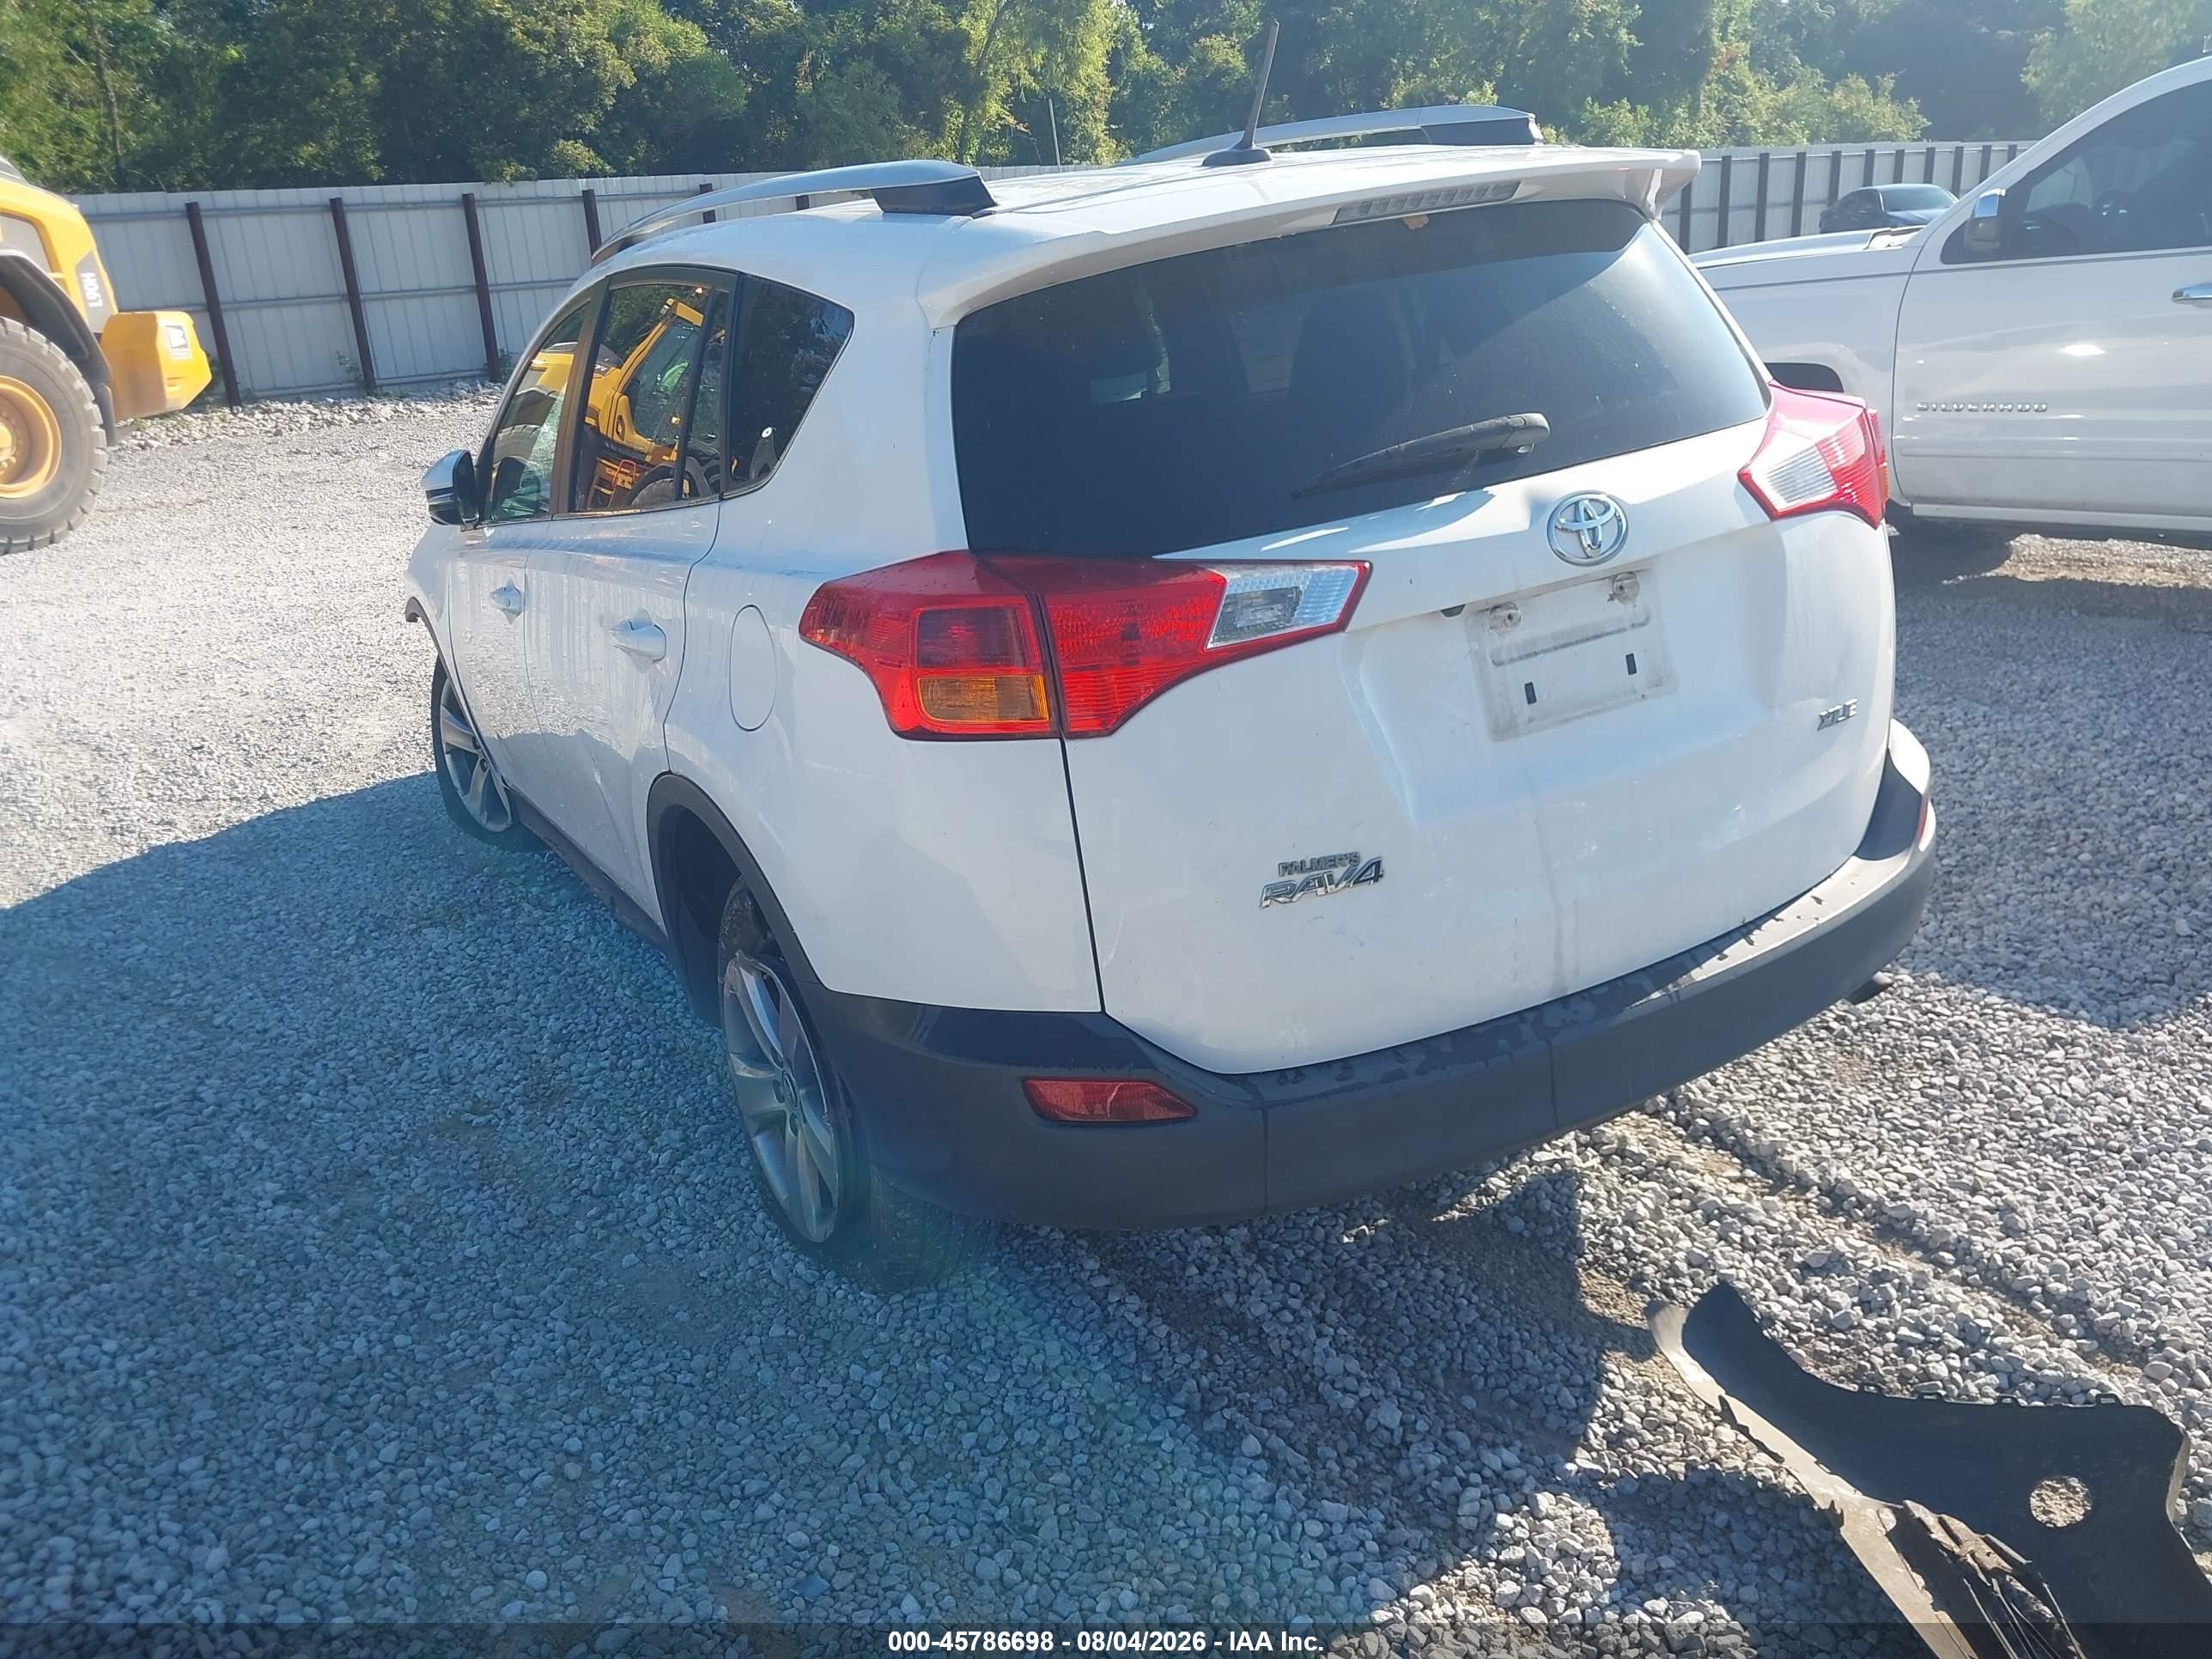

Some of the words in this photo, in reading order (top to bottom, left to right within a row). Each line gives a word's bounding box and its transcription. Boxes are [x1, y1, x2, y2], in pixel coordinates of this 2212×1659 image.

[1916, 403, 2047, 412] SILVERADO
[1278, 852, 1360, 877] PALMER'S
[1259, 857, 1385, 909] RAV4
